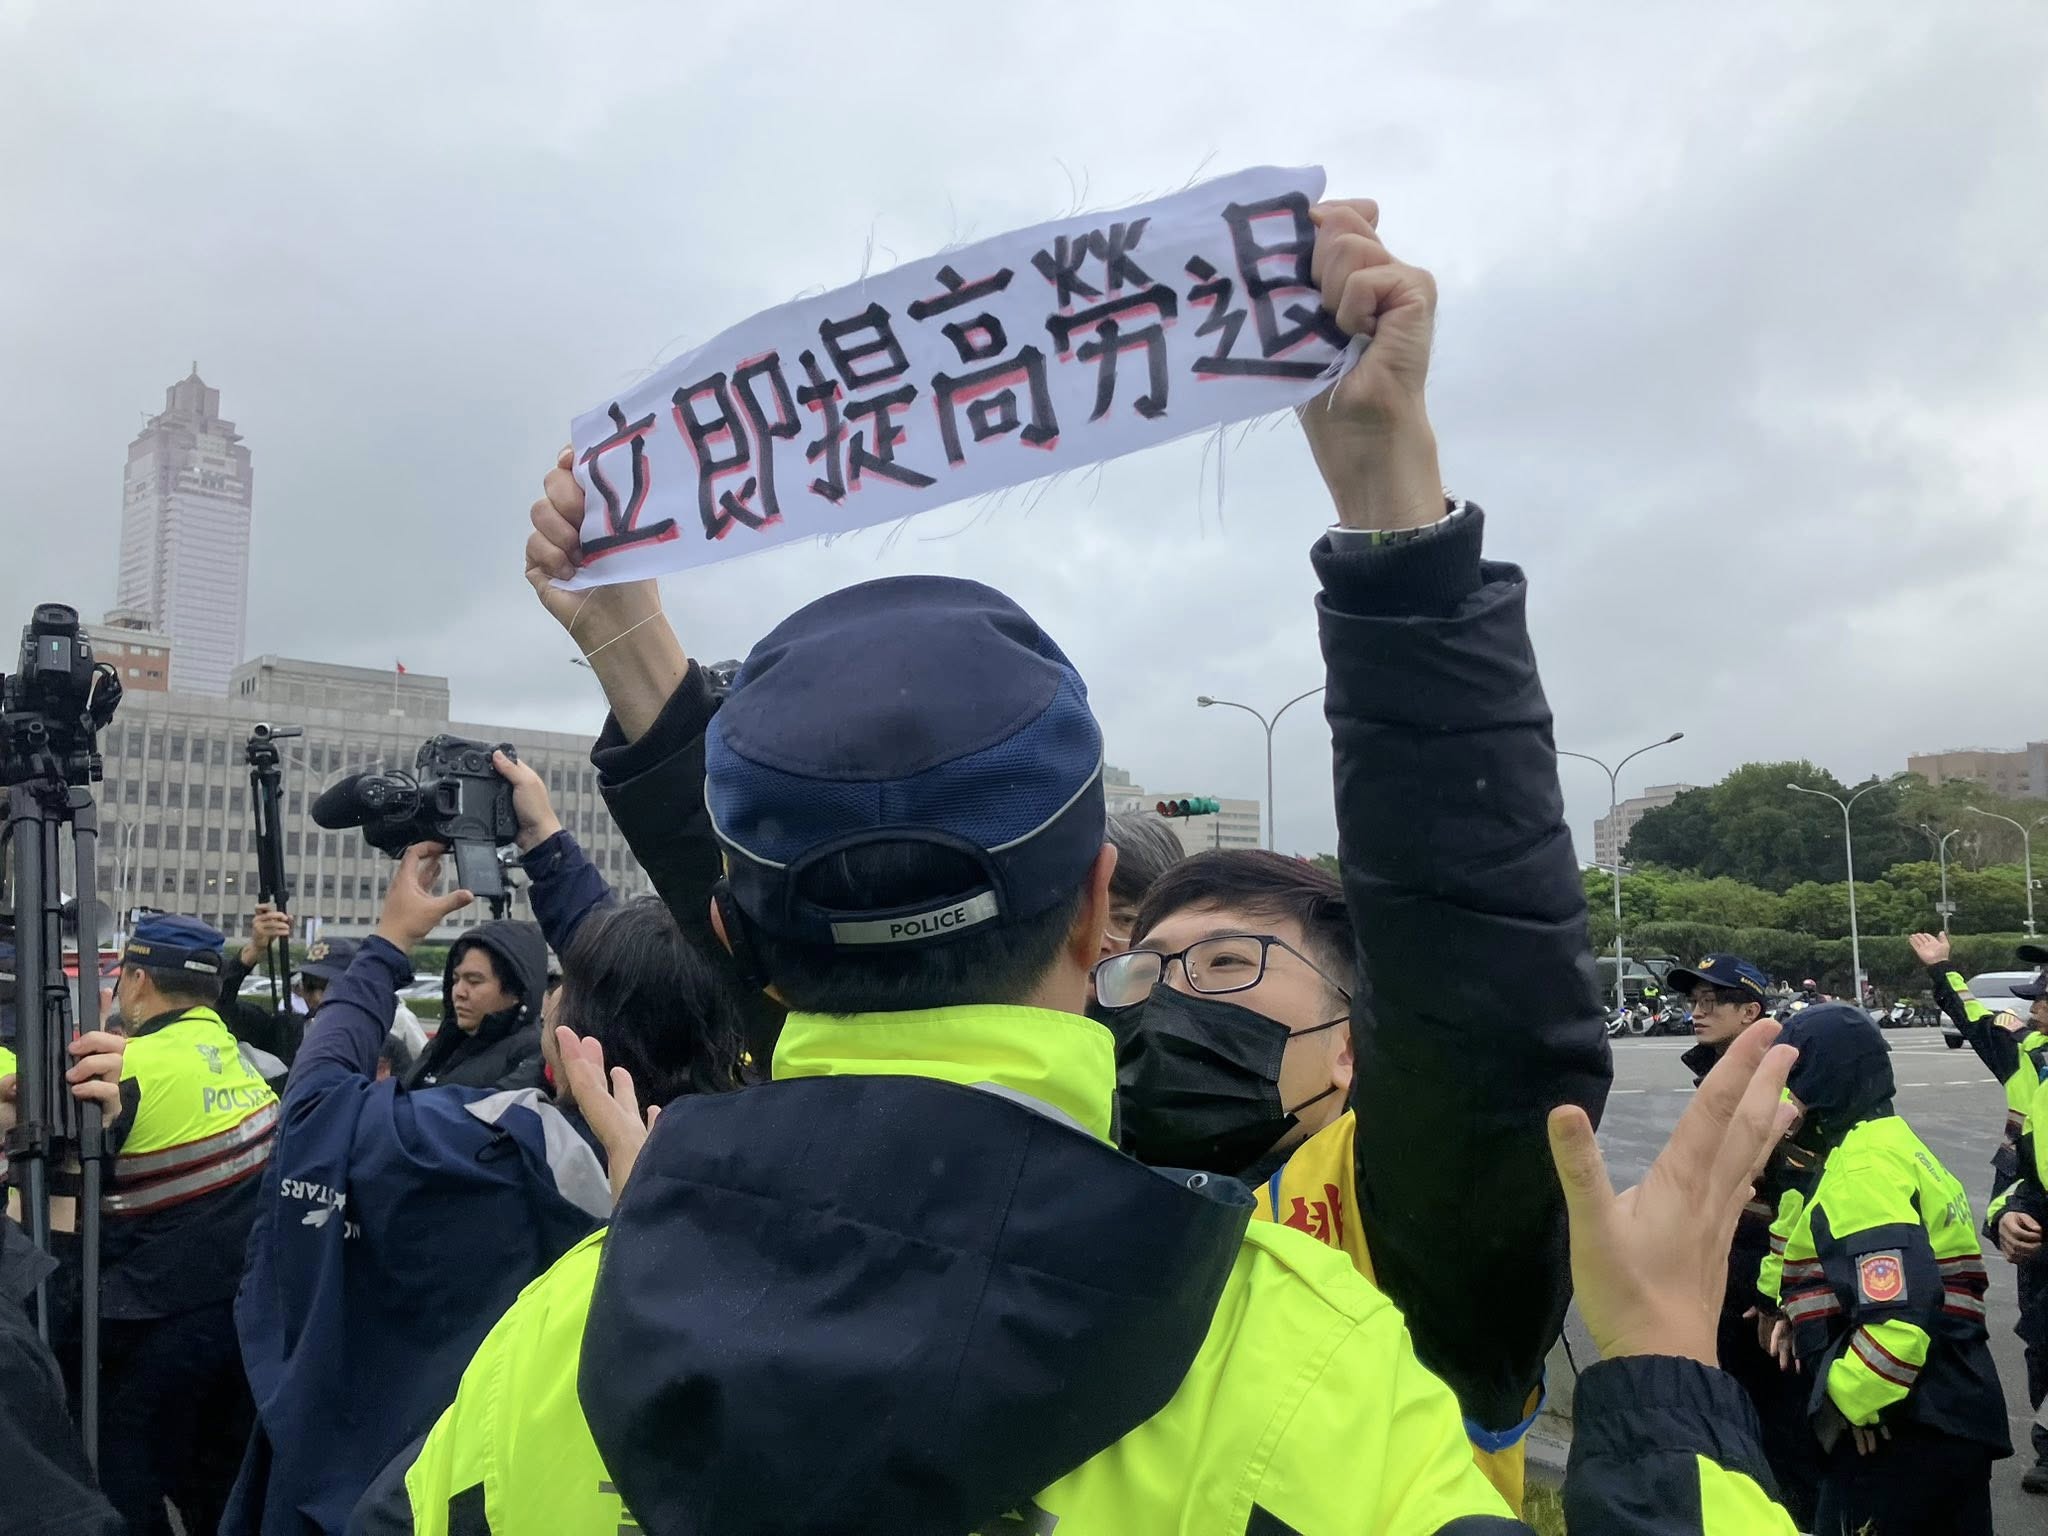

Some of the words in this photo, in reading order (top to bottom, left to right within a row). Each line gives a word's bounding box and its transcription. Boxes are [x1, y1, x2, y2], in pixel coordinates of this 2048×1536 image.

[579, 191, 1348, 568] 立即提高勞退
[890, 907, 966, 938] POLICE
